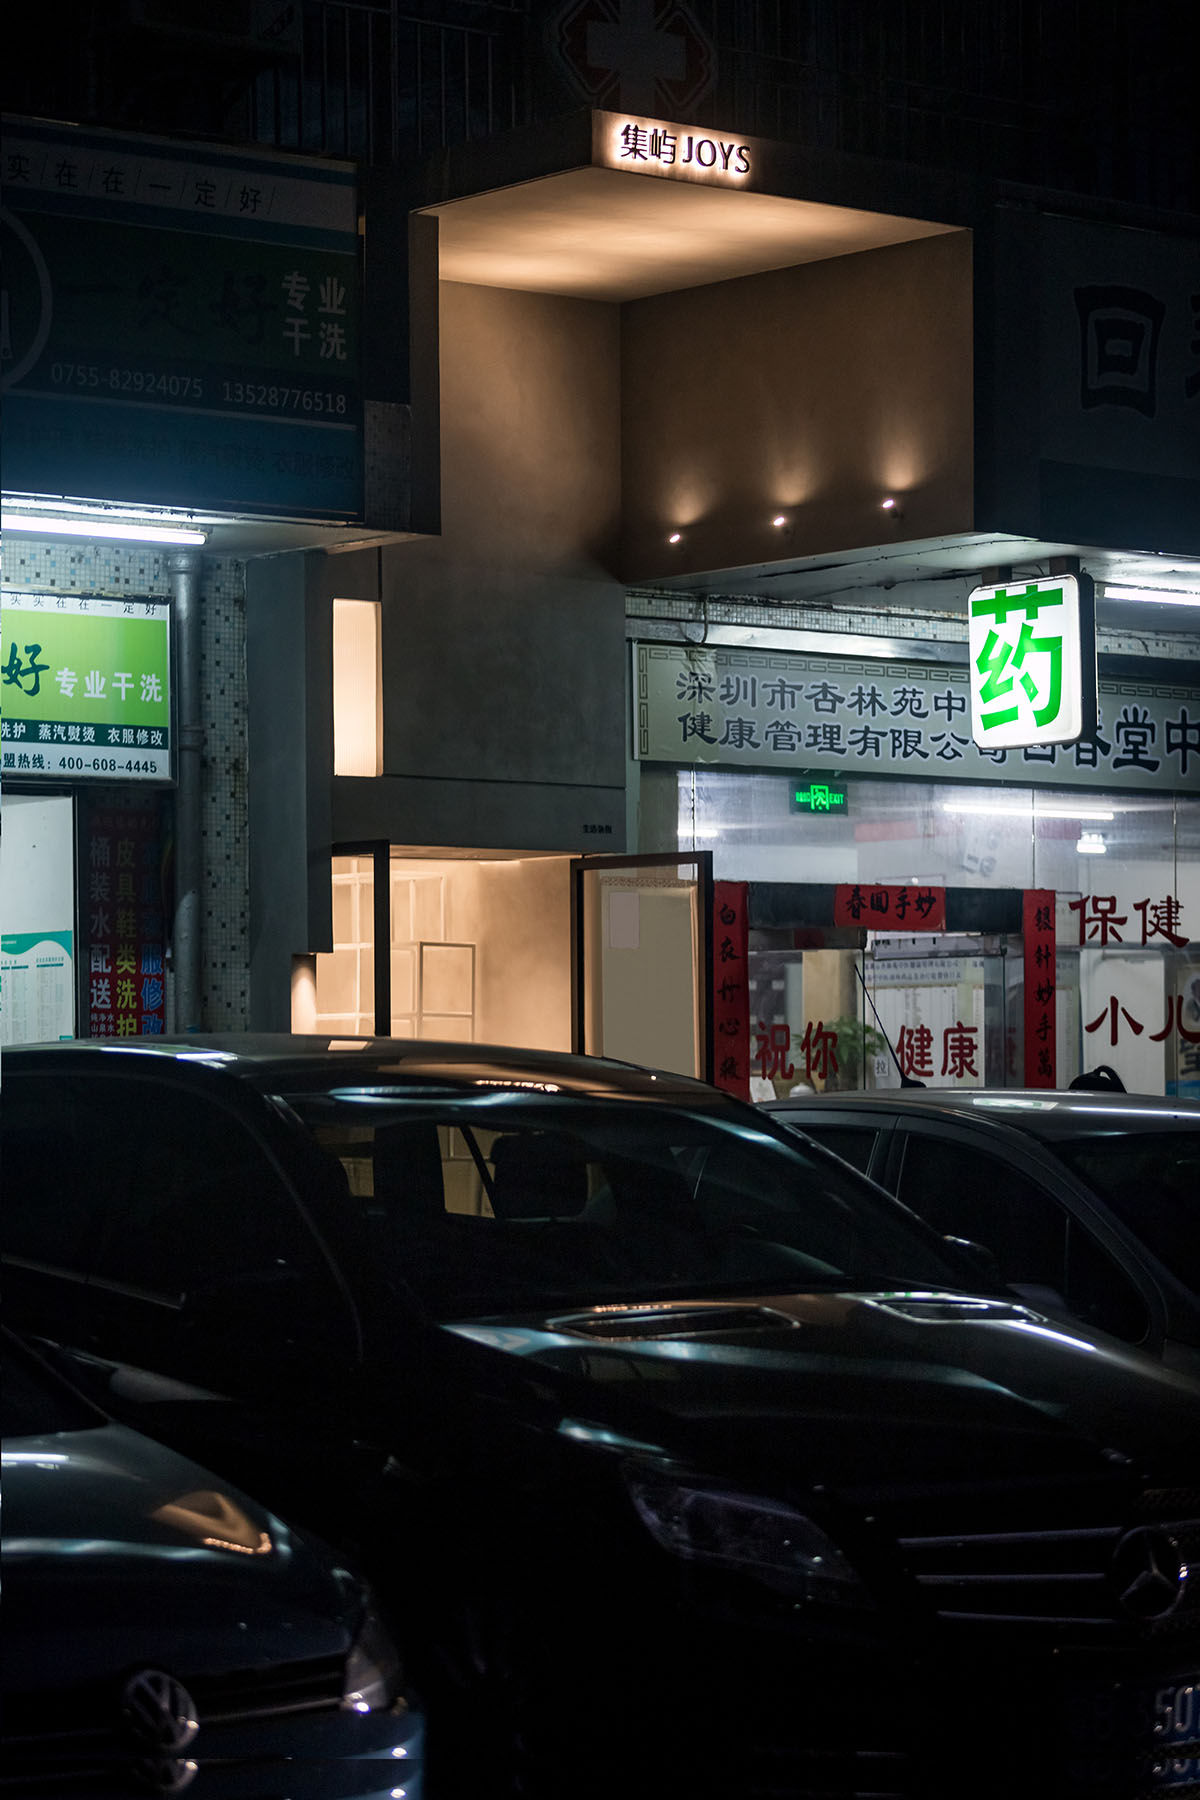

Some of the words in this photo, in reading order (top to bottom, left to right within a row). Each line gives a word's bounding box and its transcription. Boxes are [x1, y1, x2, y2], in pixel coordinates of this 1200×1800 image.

[620, 124, 677, 164] 集屿
[682, 136, 751, 174] JOYS
[281, 270, 347, 316] 专业
[282, 316, 348, 361] 干洗
[50, 362, 204, 399] 0755-82924075
[221, 381, 348, 415] 13528776518
[971, 585, 1064, 731] 药
[55, 667, 163, 704] 专业干洗
[675, 669, 967, 724] 深圳市杏林苑中
[38, 723, 97, 744] 蒸汽熨烫
[107, 727, 164, 746] 衣服修改
[58, 756, 158, 774] 400-608-4445
[89, 836, 112, 1010] 桶装水配送
[115, 837, 137, 1037] 皮具鞋类洗护
[1068, 895, 1190, 948] 保健
[1084, 995, 1200, 1047] 小儿
[755, 1020, 838, 1080] 祝你
[896, 1020, 979, 1079] 健康
